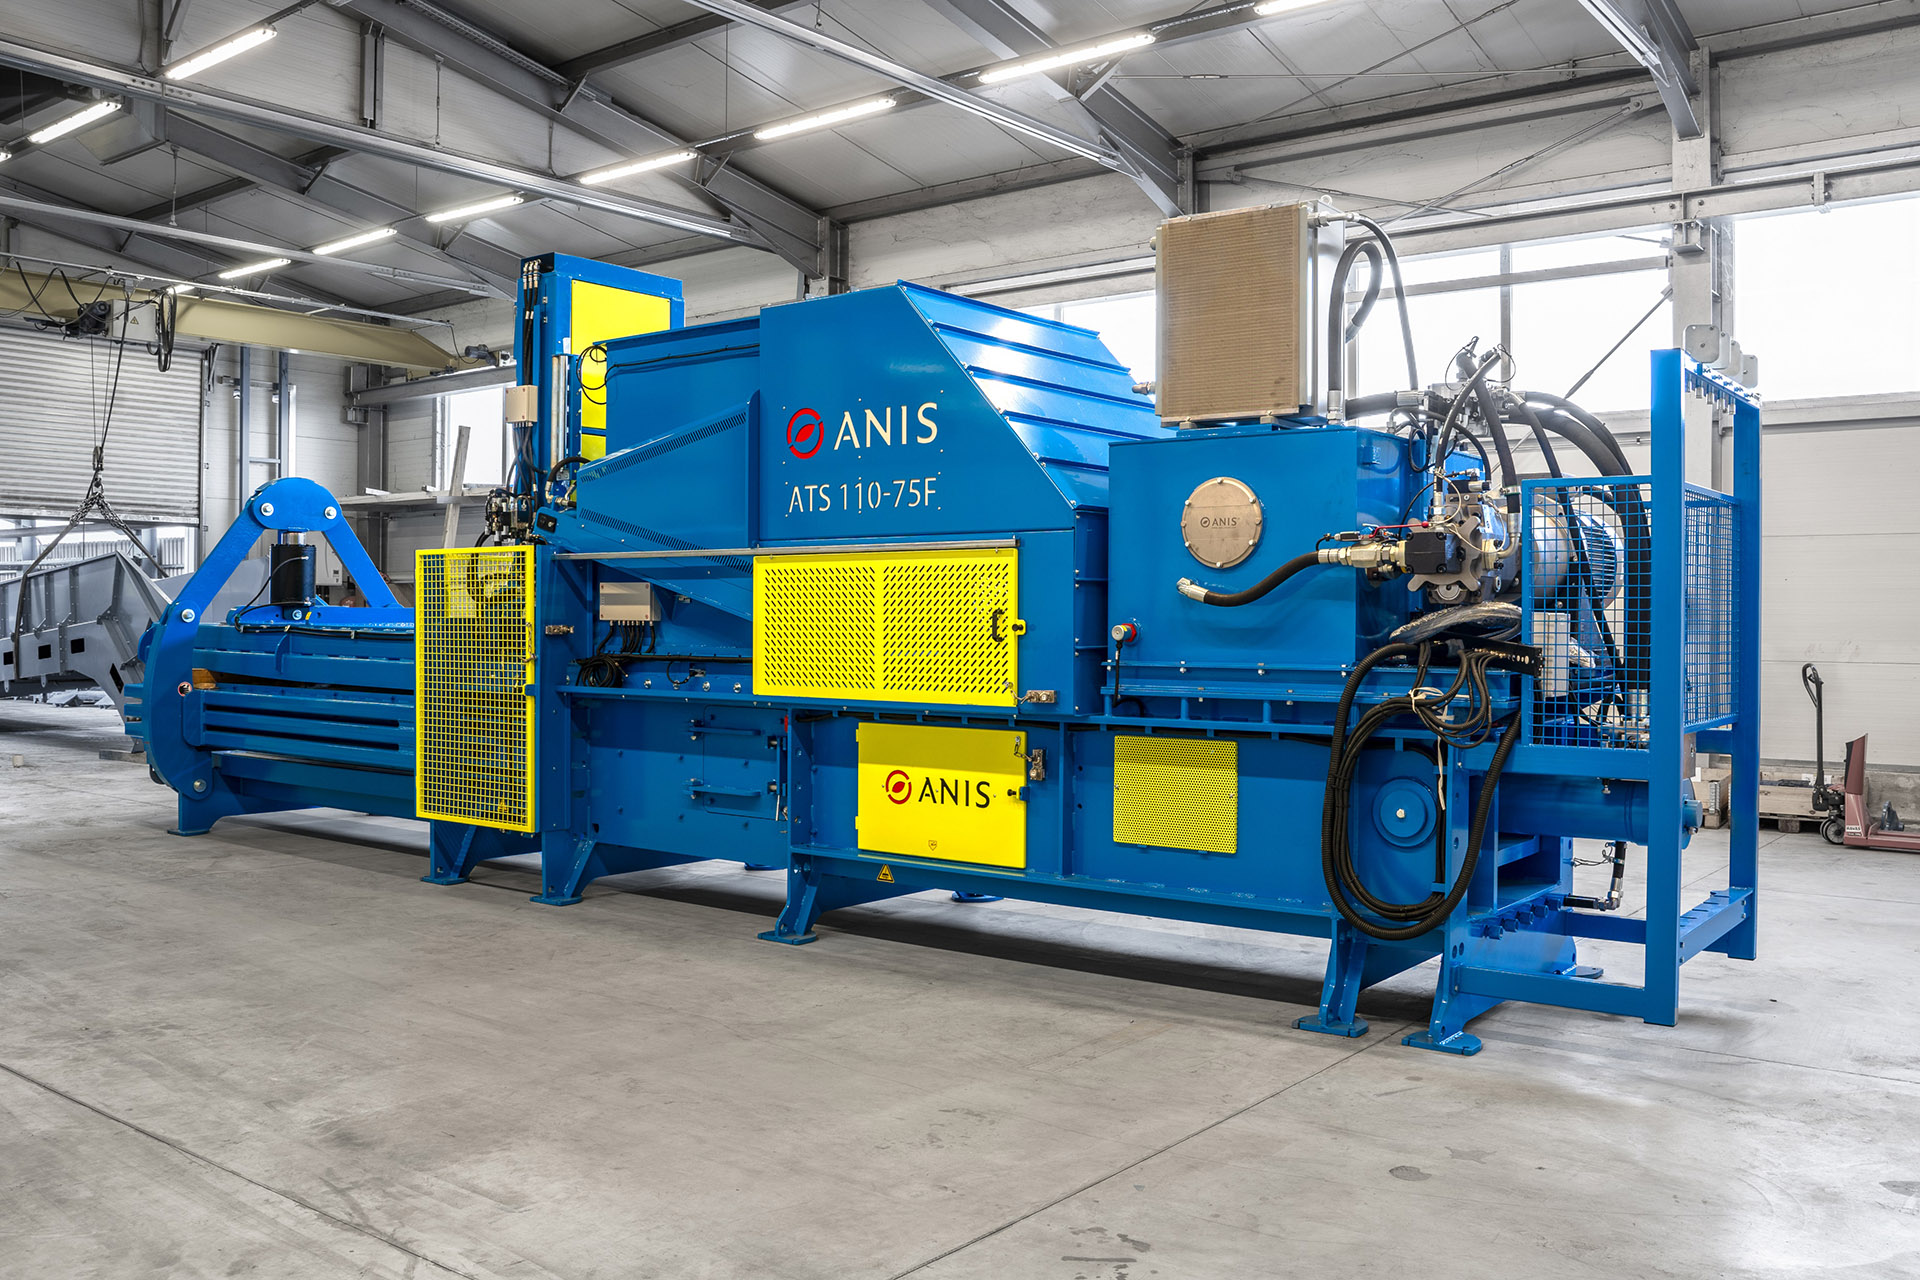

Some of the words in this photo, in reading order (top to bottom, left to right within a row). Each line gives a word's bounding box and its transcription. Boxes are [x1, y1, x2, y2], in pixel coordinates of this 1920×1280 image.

[833, 401, 938, 451] ANIS
[788, 483, 831, 513] ATS
[840, 477, 937, 511] 110-75F
[1212, 517, 1237, 526] ANIS
[918, 776, 990, 809] ANIS
